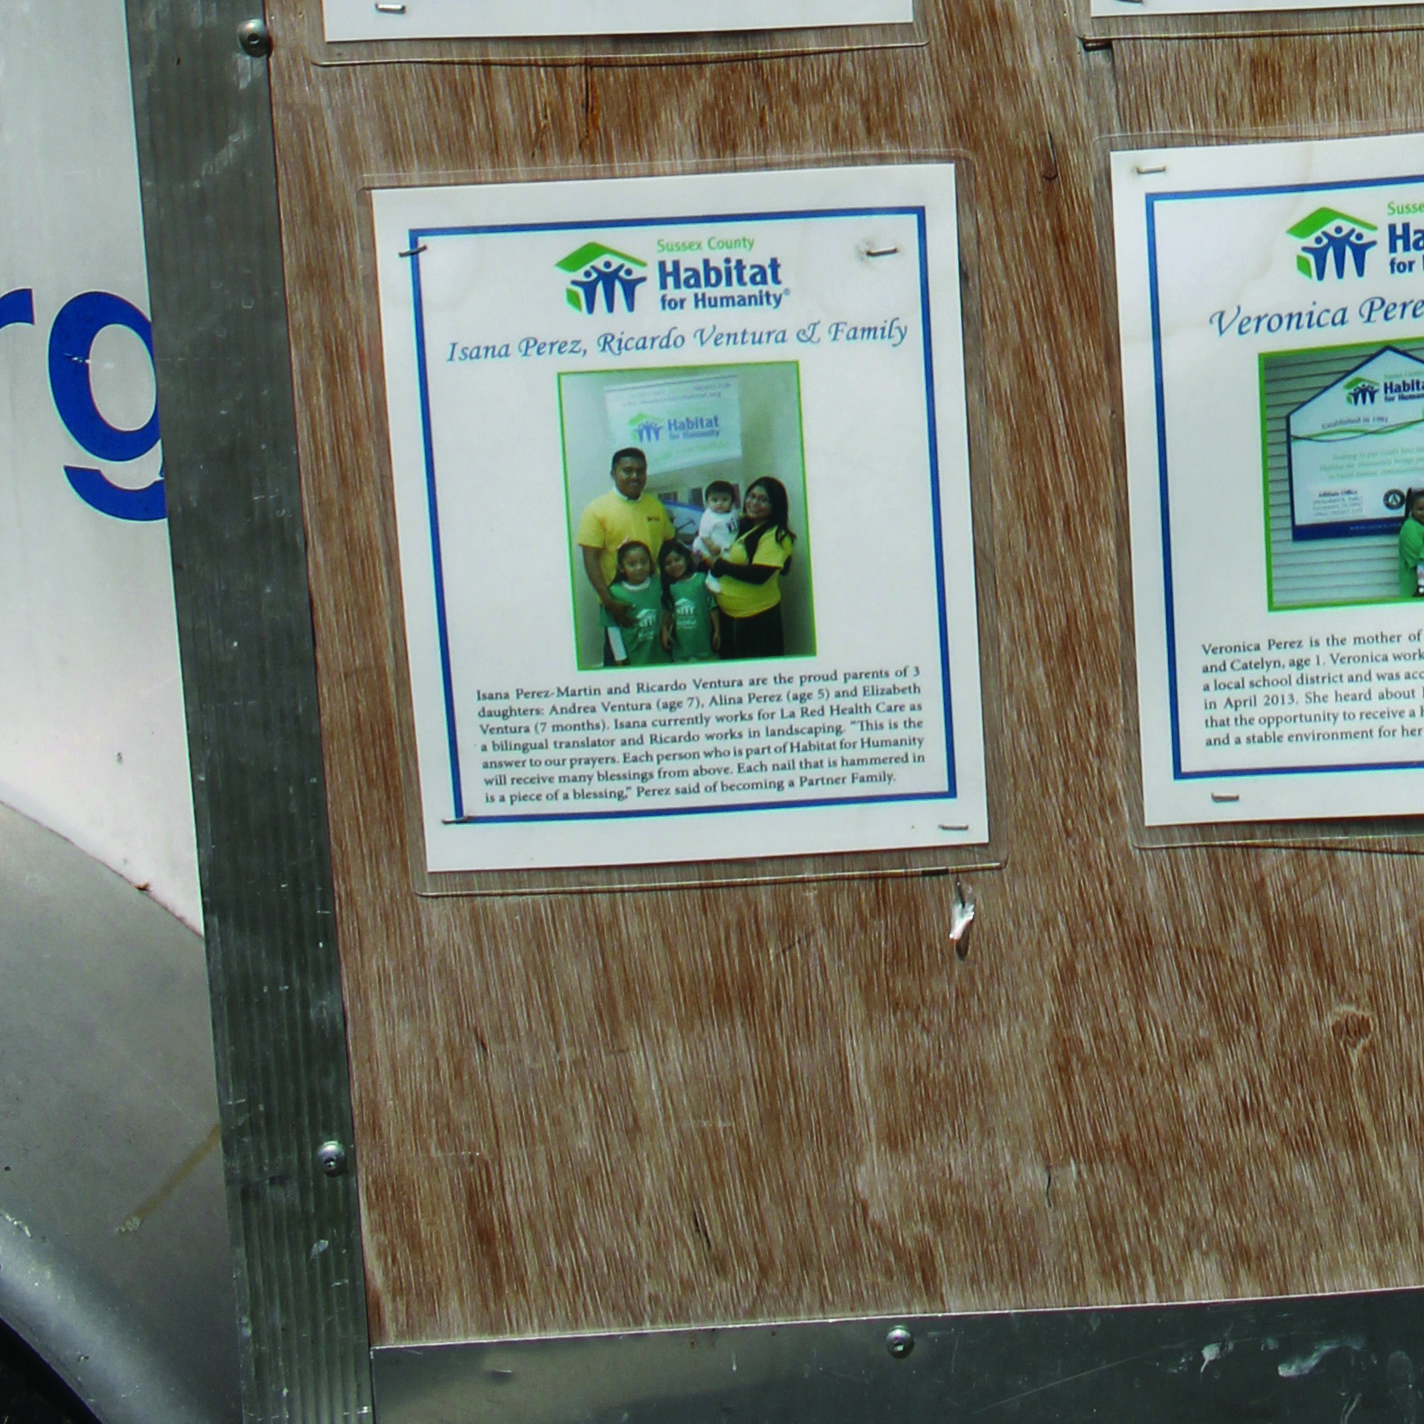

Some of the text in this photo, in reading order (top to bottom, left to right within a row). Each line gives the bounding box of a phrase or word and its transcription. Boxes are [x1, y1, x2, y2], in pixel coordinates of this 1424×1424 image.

[657, 238, 754, 252] Sussex County
[658, 257, 782, 294] Habitat
[1389, 257, 1415, 274] for
[660, 294, 686, 311] for
[1209, 301, 1347, 337] Veronica
[447, 342, 510, 362] Isana
[518, 337, 587, 357] Perez,
[597, 327, 685, 356] Ricardo
[693, 325, 787, 347] Ventura
[828, 317, 907, 347] Family
[1206, 733, 1230, 747] and
[1246, 731, 1283, 745] stable
[1288, 729, 1373, 743] environment
[1378, 726, 1396, 739] for
[1401, 725, 1422, 737] her
